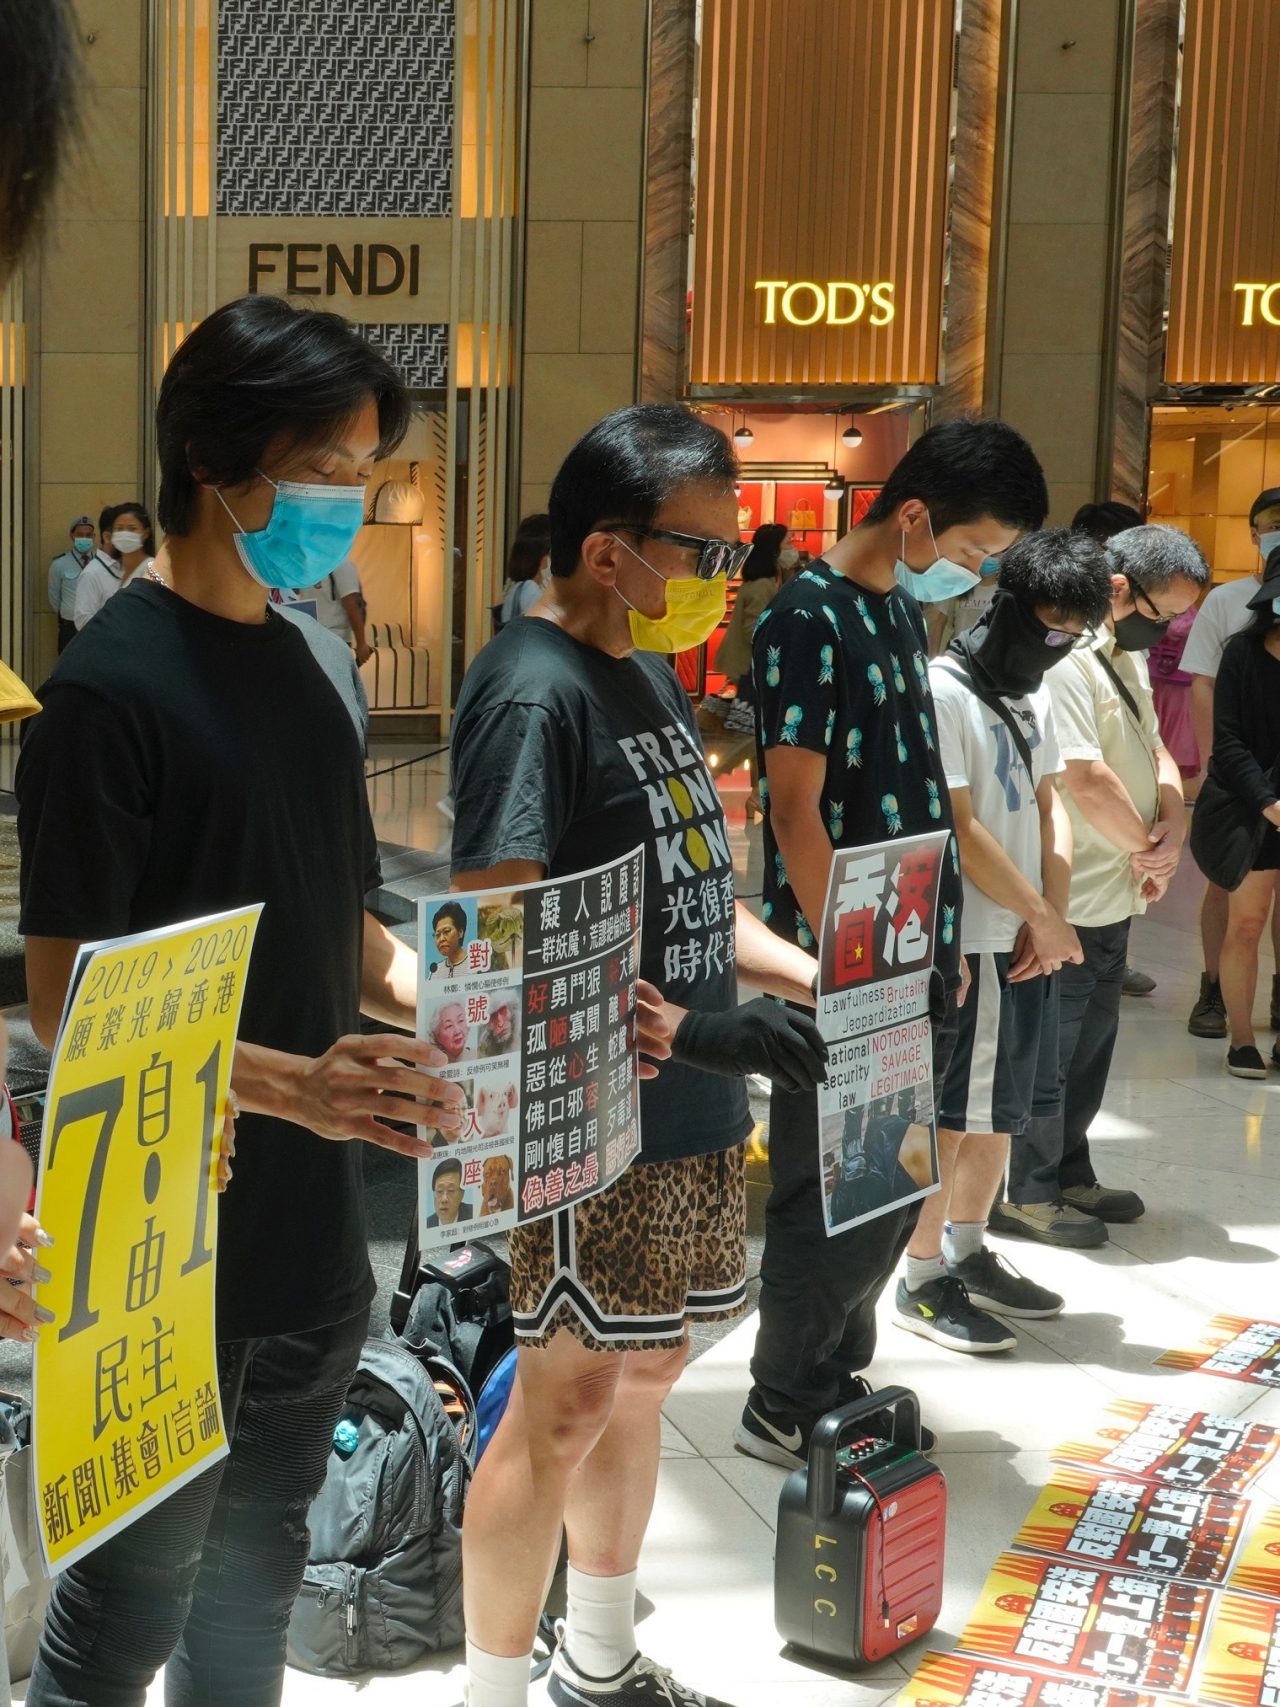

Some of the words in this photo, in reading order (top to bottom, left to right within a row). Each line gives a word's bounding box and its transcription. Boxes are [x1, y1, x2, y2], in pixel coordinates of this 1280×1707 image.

[248, 243, 421, 296] FENDI
[755, 281, 896, 326] TOD'S
[642, 767, 723, 829] HON
[656, 816, 732, 884] KON
[83, 951, 159, 1006] 2019
[184, 925, 248, 975] 2020
[527, 966, 602, 1015] 好勇鬥狠
[823, 986, 885, 1014] Lawfulness
[887, 977, 929, 1002] Brutality
[64, 972, 236, 1062] 願榮光歸香港
[842, 1000, 917, 1035] Jeopardization
[872, 1020, 930, 1052] NOTORIOUS
[526, 1042, 600, 1094] 惡從心生
[823, 1064, 870, 1091] security
[871, 1062, 931, 1099] LEGITIMACY
[881, 1044, 921, 1073] SAVAGE
[839, 1091, 857, 1110] law
[521, 1152, 599, 1214] 偽善之最
[92, 1316, 178, 1442] 民主
